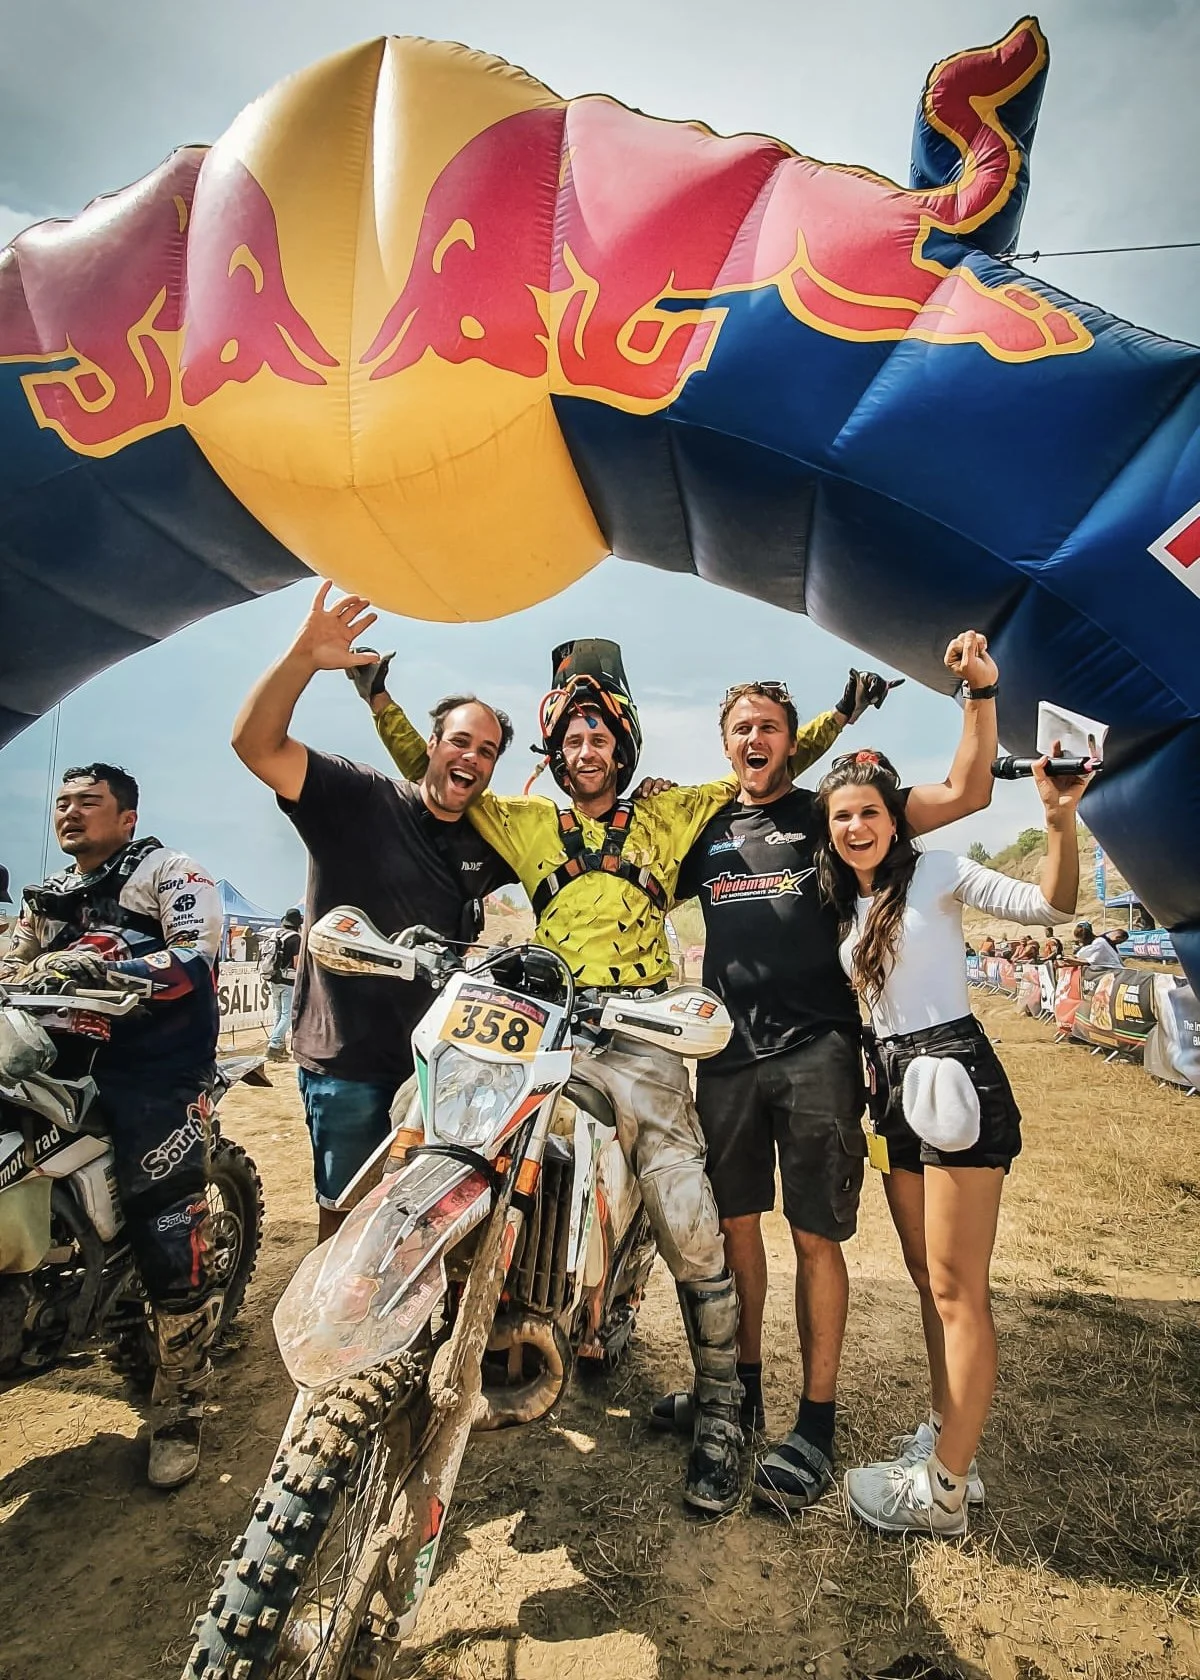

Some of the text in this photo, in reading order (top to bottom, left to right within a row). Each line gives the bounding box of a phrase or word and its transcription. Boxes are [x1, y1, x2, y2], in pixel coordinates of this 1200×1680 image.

[173, 912, 194, 922] MRK
[167, 918, 204, 929] Motorrad
[451, 1004, 529, 1053] 358
[1184, 1020, 1194, 1031] The
